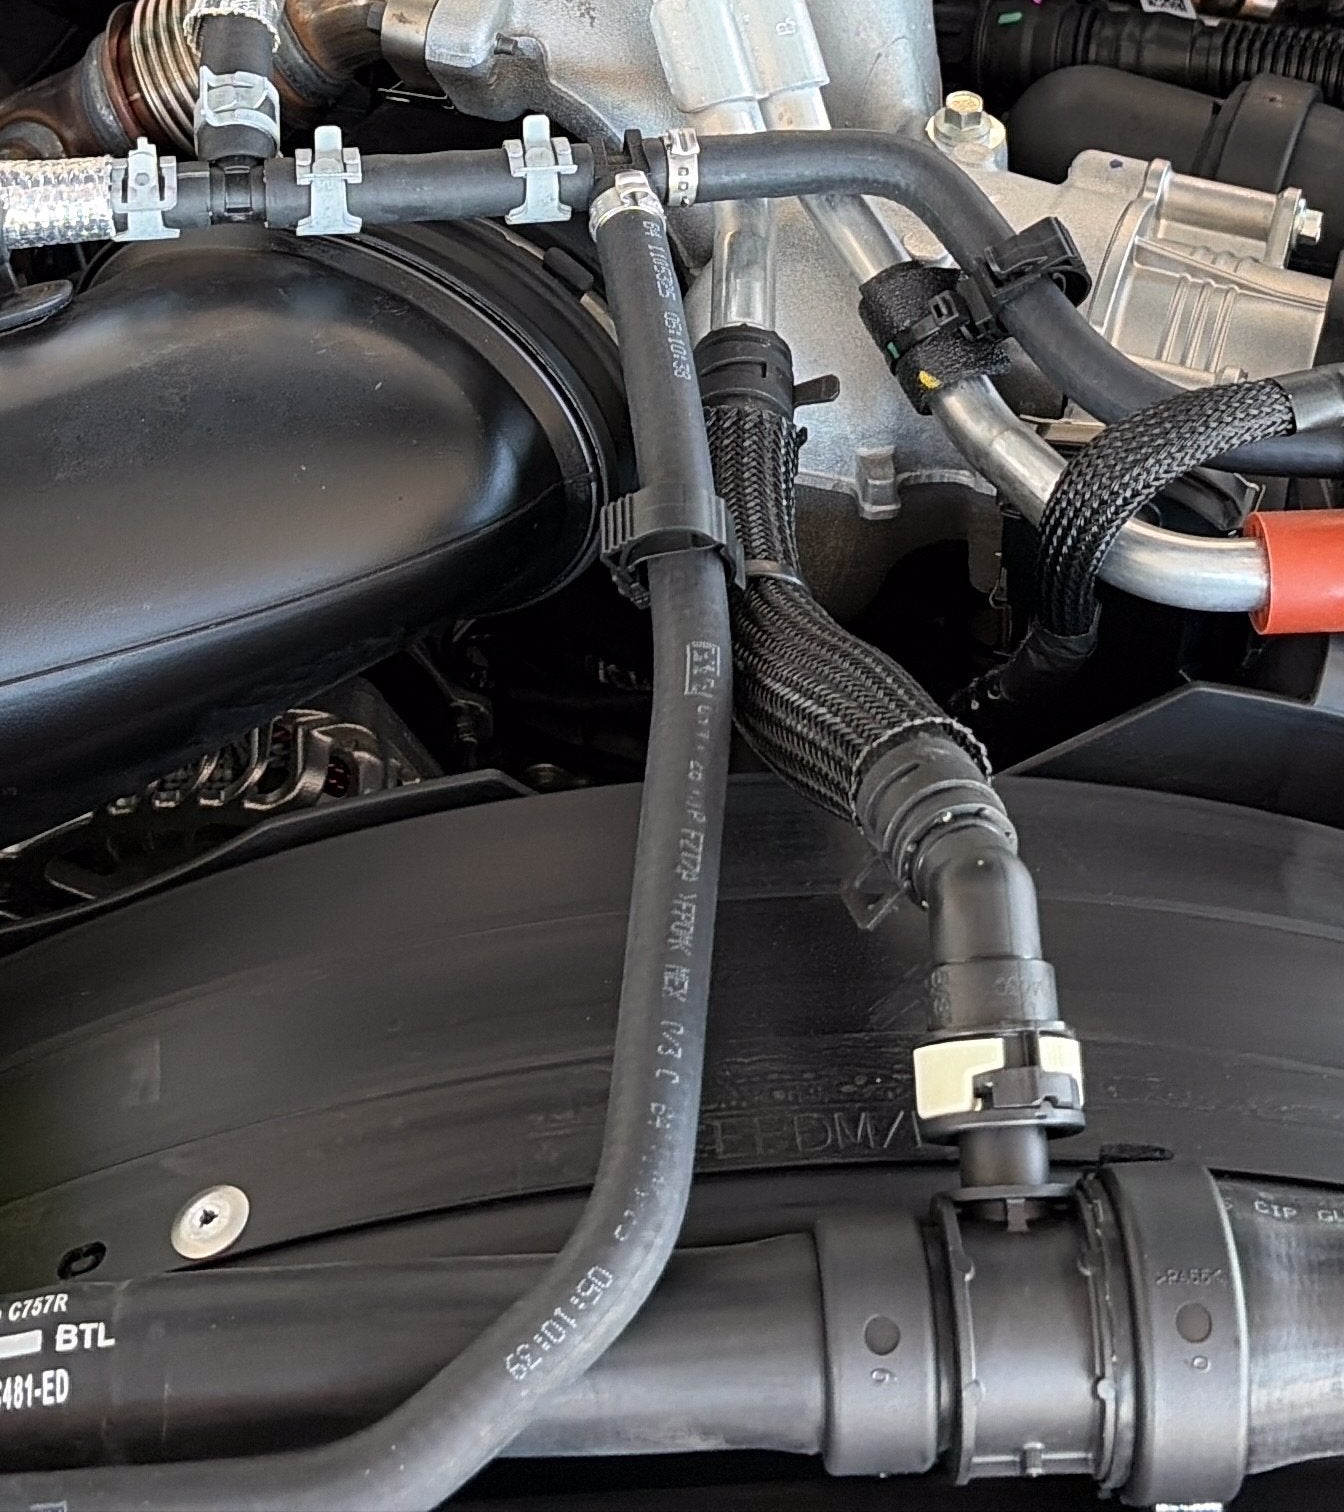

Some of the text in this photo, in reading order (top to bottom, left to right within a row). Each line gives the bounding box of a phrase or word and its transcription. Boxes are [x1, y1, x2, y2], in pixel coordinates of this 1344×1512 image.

[1254, 1199, 1298, 1219] CIP
[8, 1293, 69, 1322] C757R
[54, 1321, 116, 1352] BTL
[506, 1264, 614, 1382] 05:10:39
